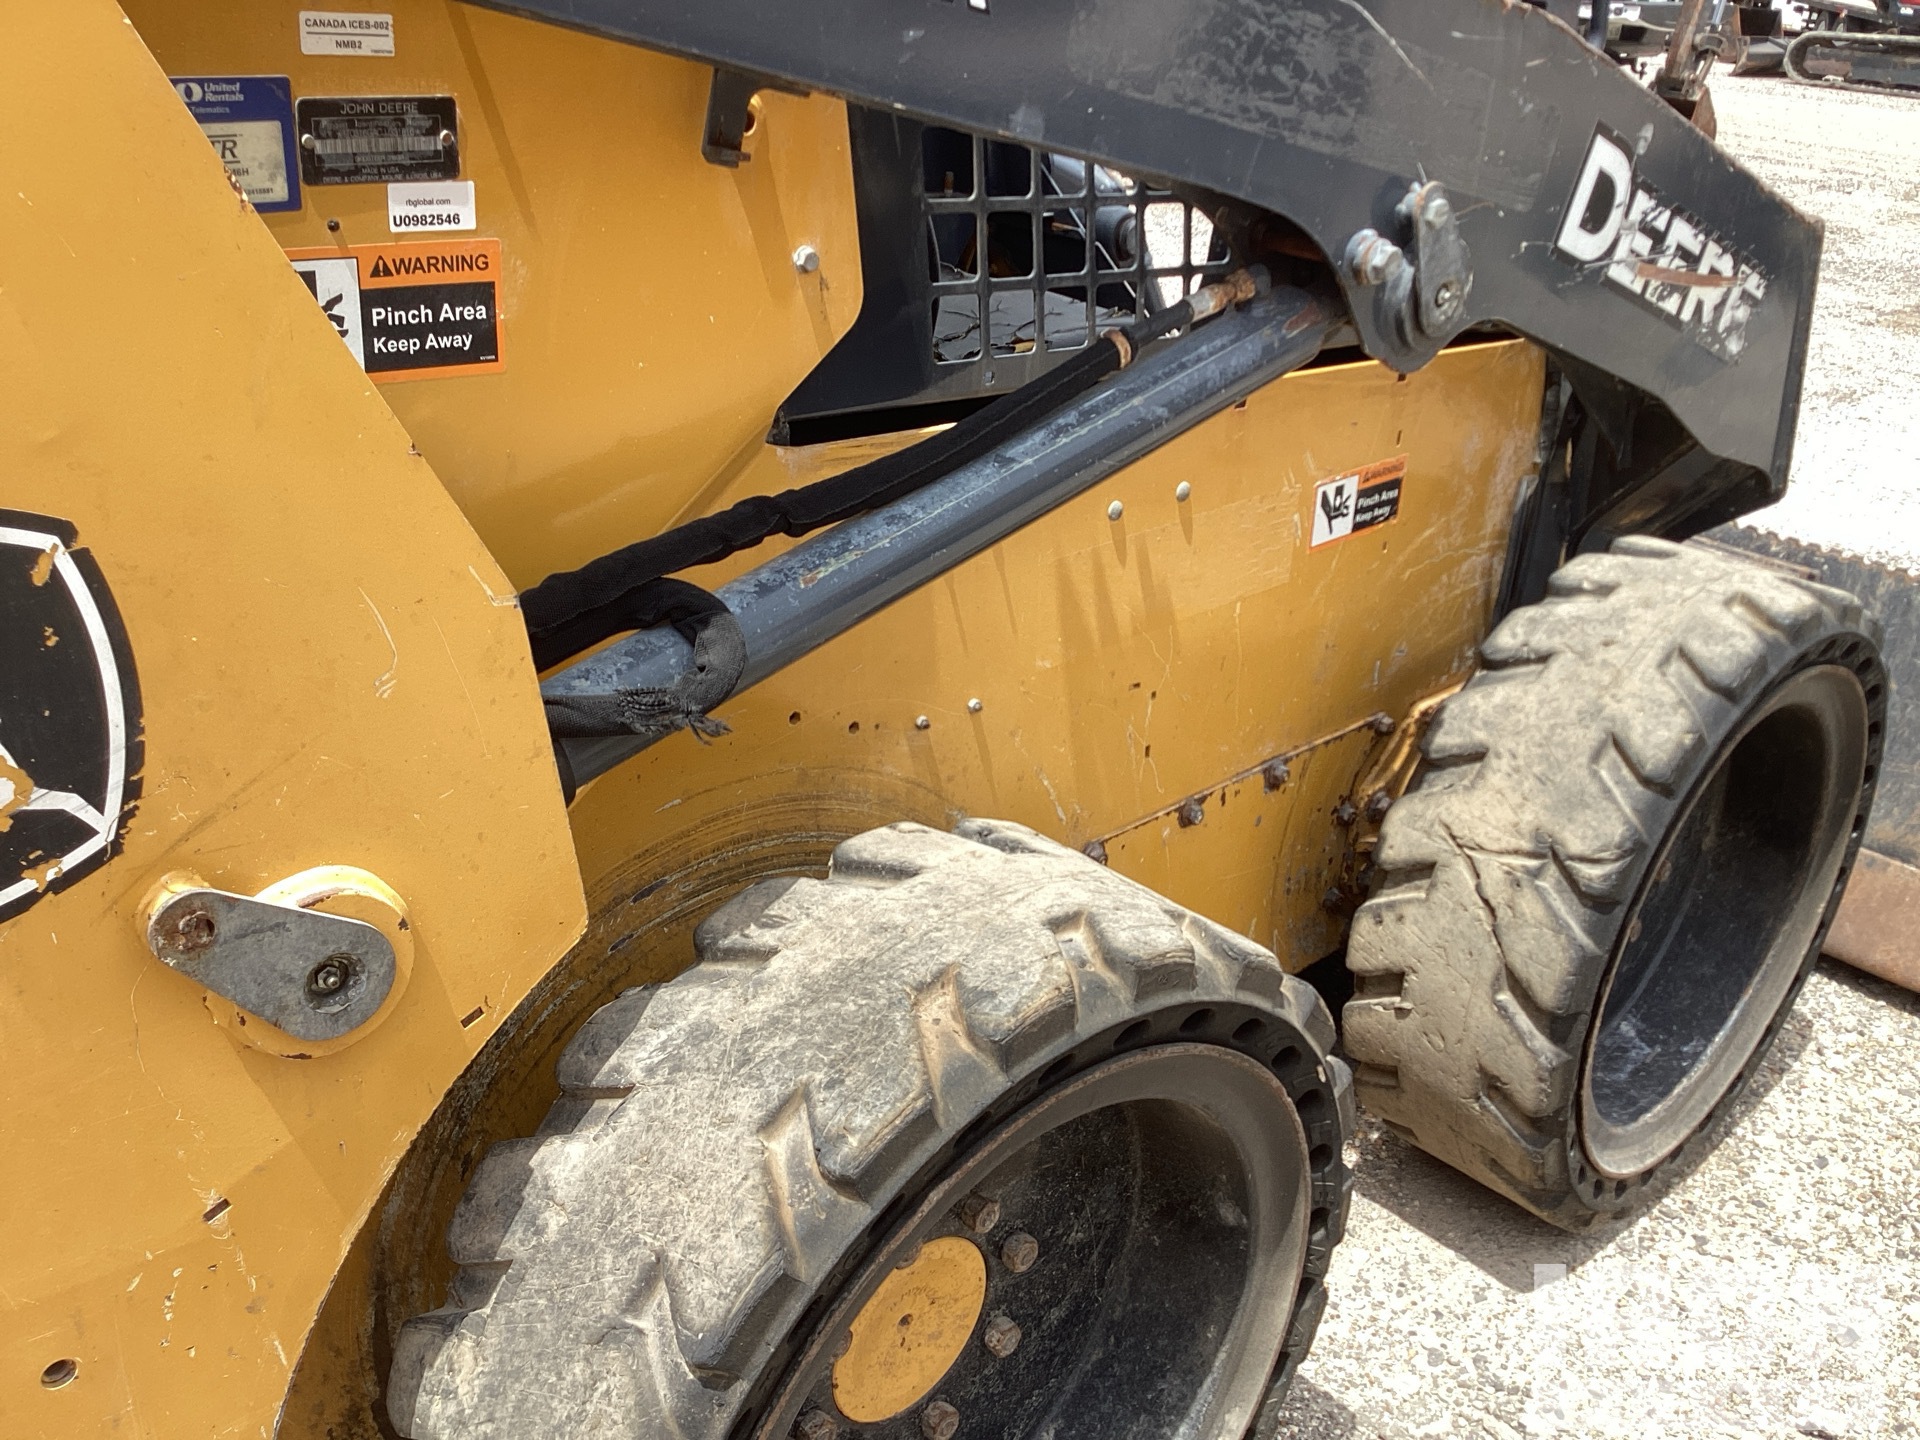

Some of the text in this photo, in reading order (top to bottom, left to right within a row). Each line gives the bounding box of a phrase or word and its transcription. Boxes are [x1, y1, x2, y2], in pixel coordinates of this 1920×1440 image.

[304, 18, 390, 31] CANADA ICES-002
[335, 39, 363, 49] NMB2
[203, 81, 240, 92] United
[204, 92, 245, 102] Rentals
[340, 102, 419, 115] JOHN DEERE
[405, 197, 451, 208] rbglobal.com
[392, 212, 461, 228] U0982546
[391, 253, 490, 275] WARNING
[371, 303, 487, 327] Pinch Area
[373, 332, 473, 355] Keep Away
[1357, 488, 1399, 508] Pinch Area
[1355, 504, 1392, 523] Keep Away
